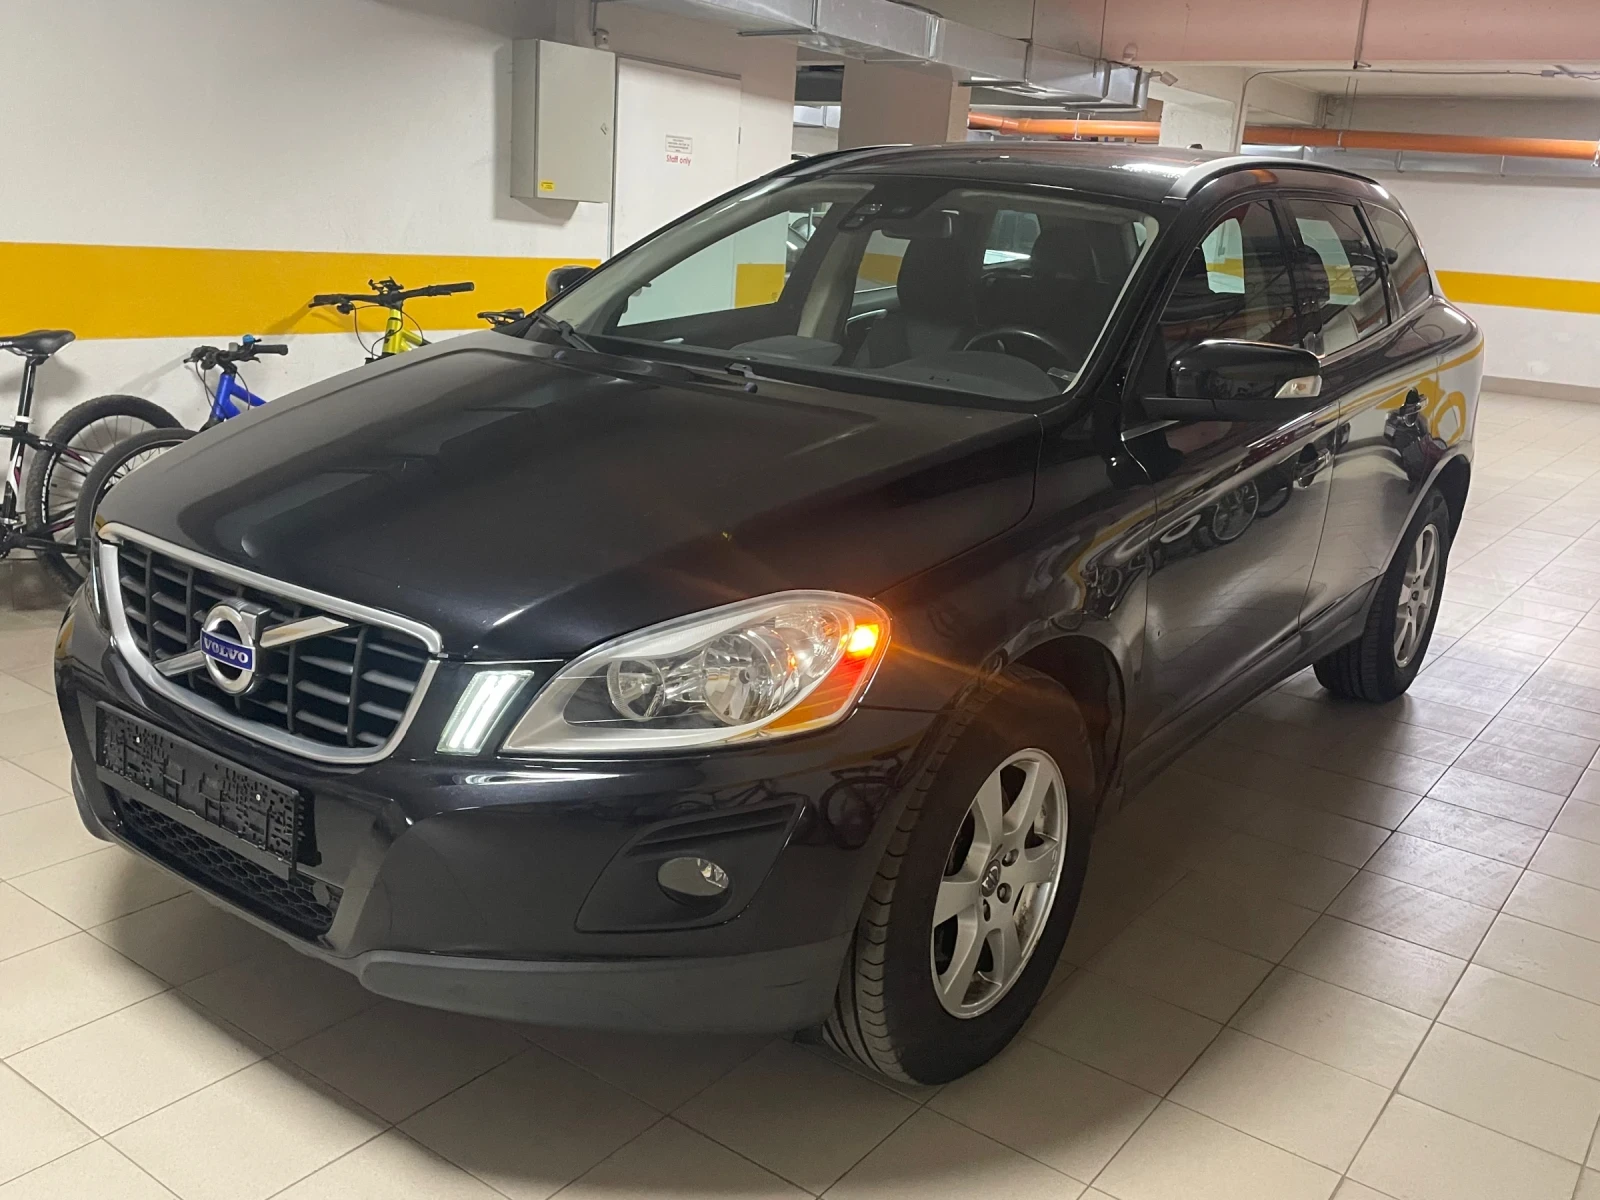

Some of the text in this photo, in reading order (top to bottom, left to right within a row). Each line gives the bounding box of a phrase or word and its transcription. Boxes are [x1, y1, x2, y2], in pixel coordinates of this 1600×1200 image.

[666, 154, 692, 166] Staff only
[203, 636, 249, 664] VOLVO
